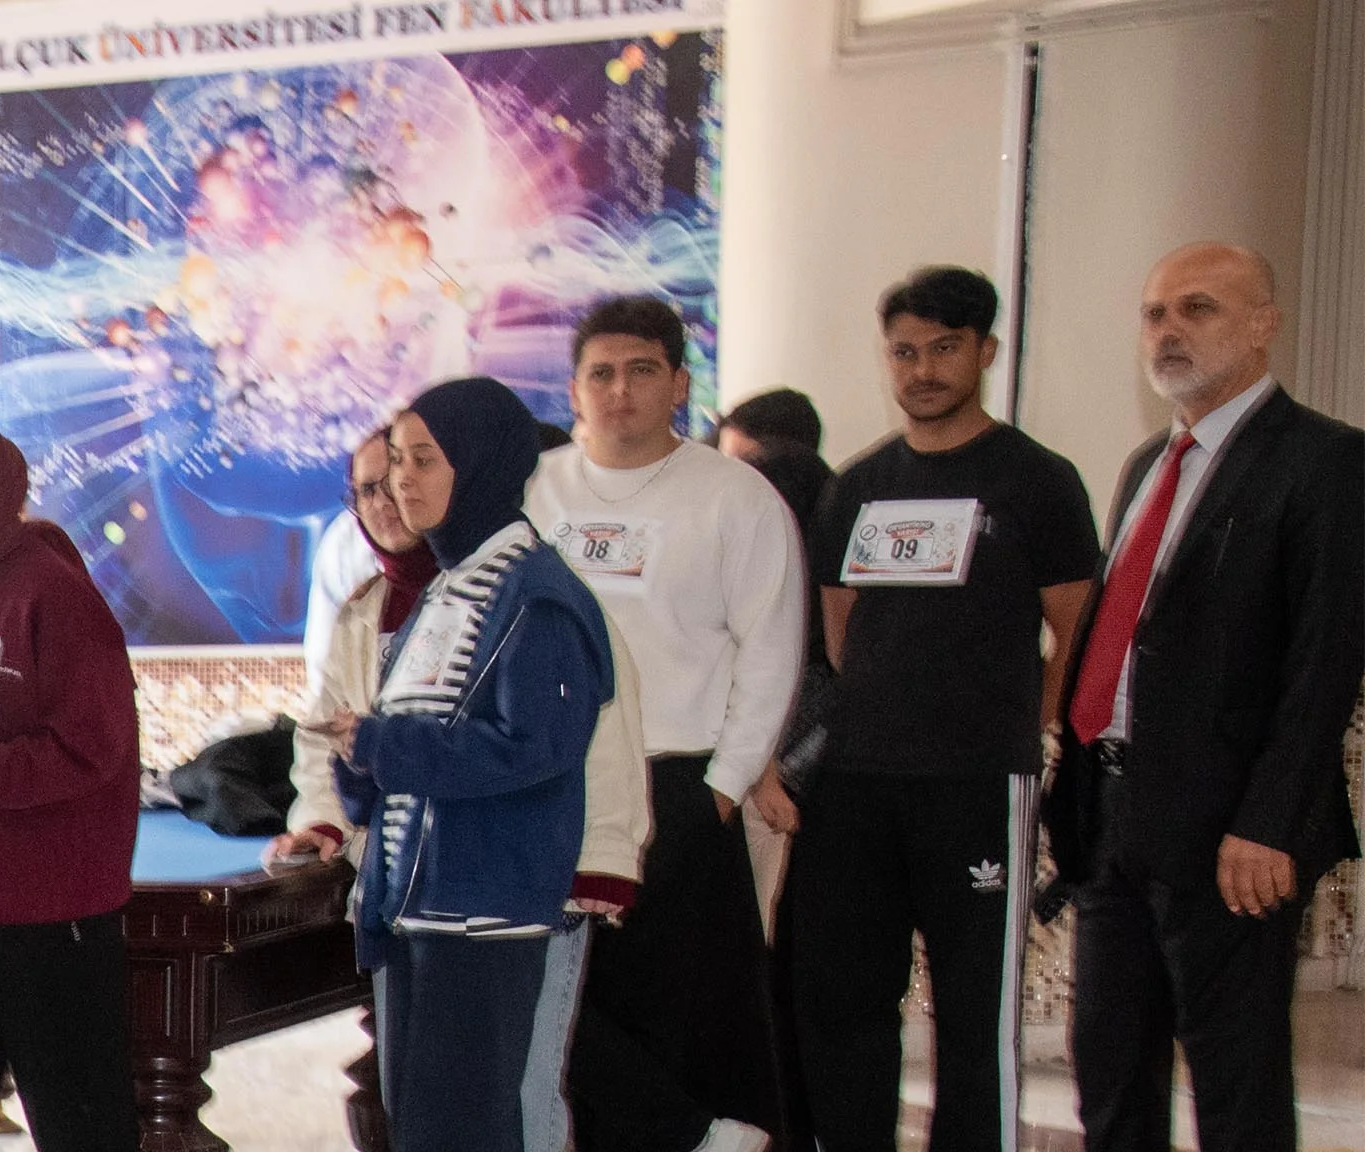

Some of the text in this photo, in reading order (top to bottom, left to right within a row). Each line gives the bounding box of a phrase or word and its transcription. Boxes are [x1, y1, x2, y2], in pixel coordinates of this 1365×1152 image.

[372, 4, 444, 37] FEN
[583, 539, 609, 559] 08
[891, 538, 918, 559] 09
[972, 879, 1001, 888] adidas
